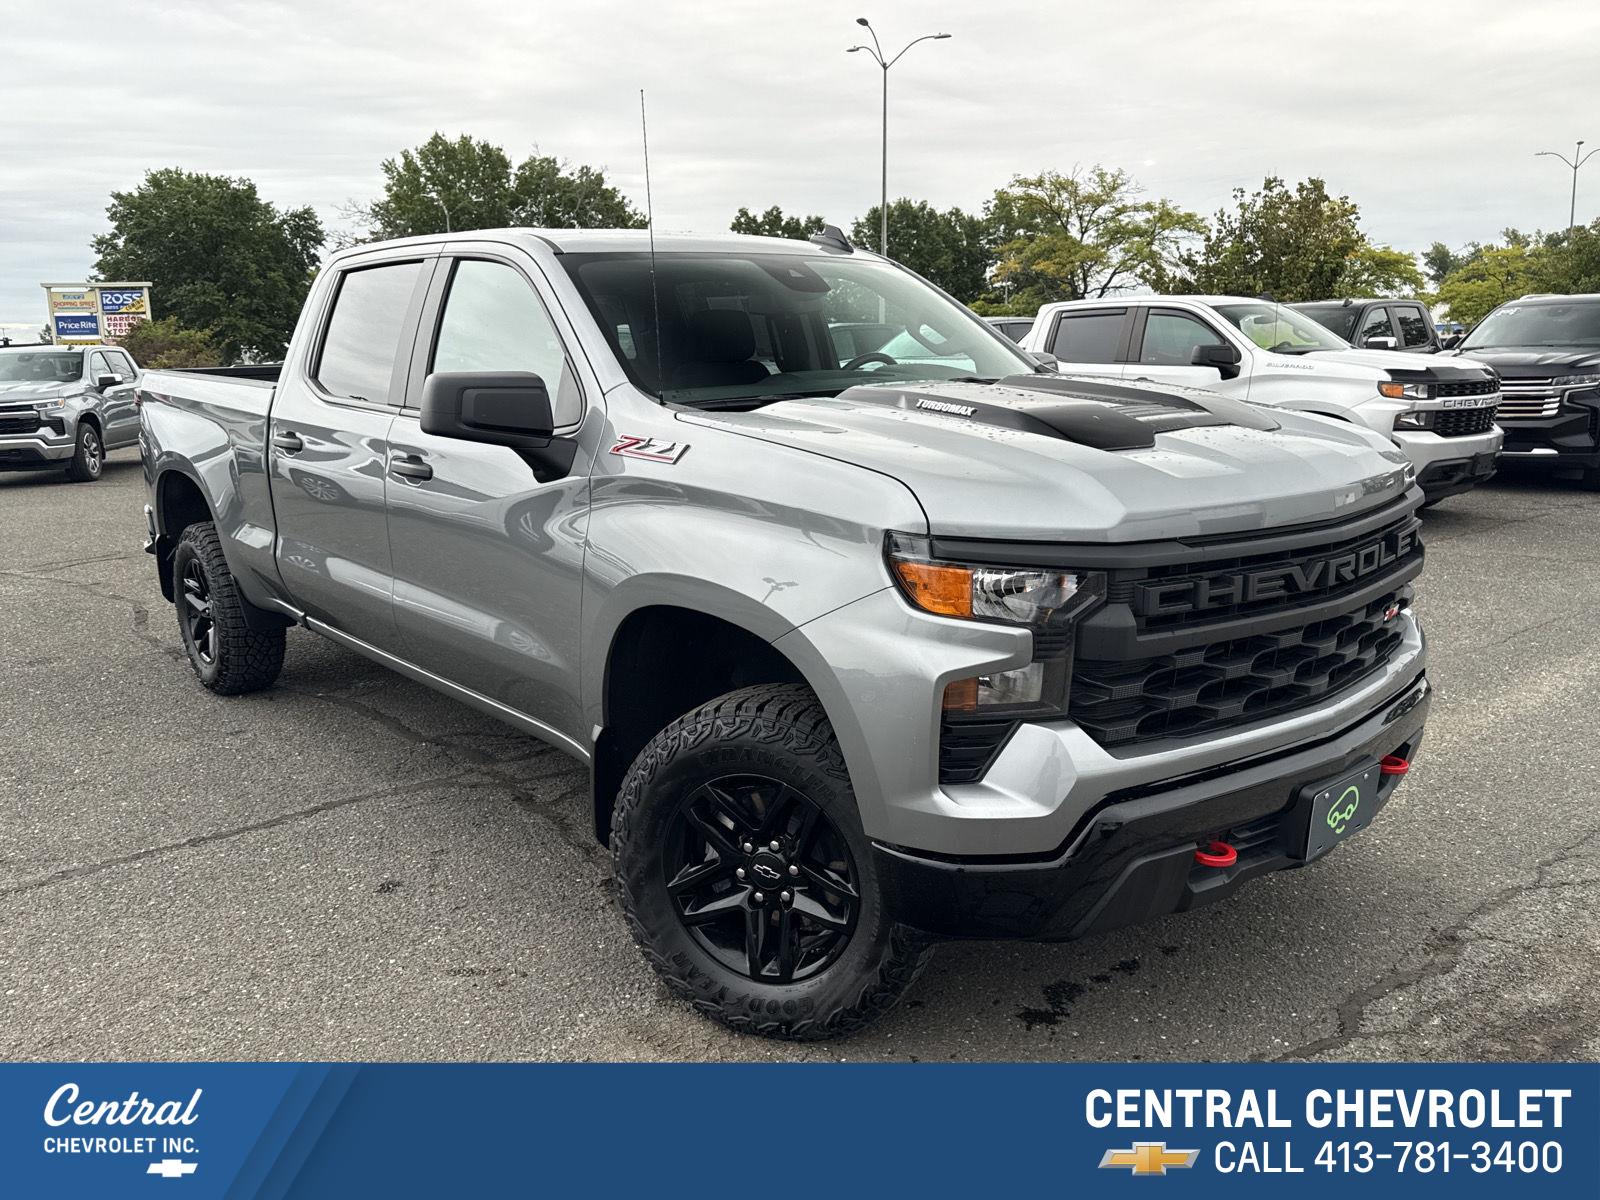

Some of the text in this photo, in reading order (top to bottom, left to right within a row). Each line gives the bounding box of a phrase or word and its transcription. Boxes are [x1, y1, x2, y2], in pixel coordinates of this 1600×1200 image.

[102, 293, 141, 305] ROSS
[915, 398, 978, 417] TURBOMAX
[608, 434, 691, 465] Z71
